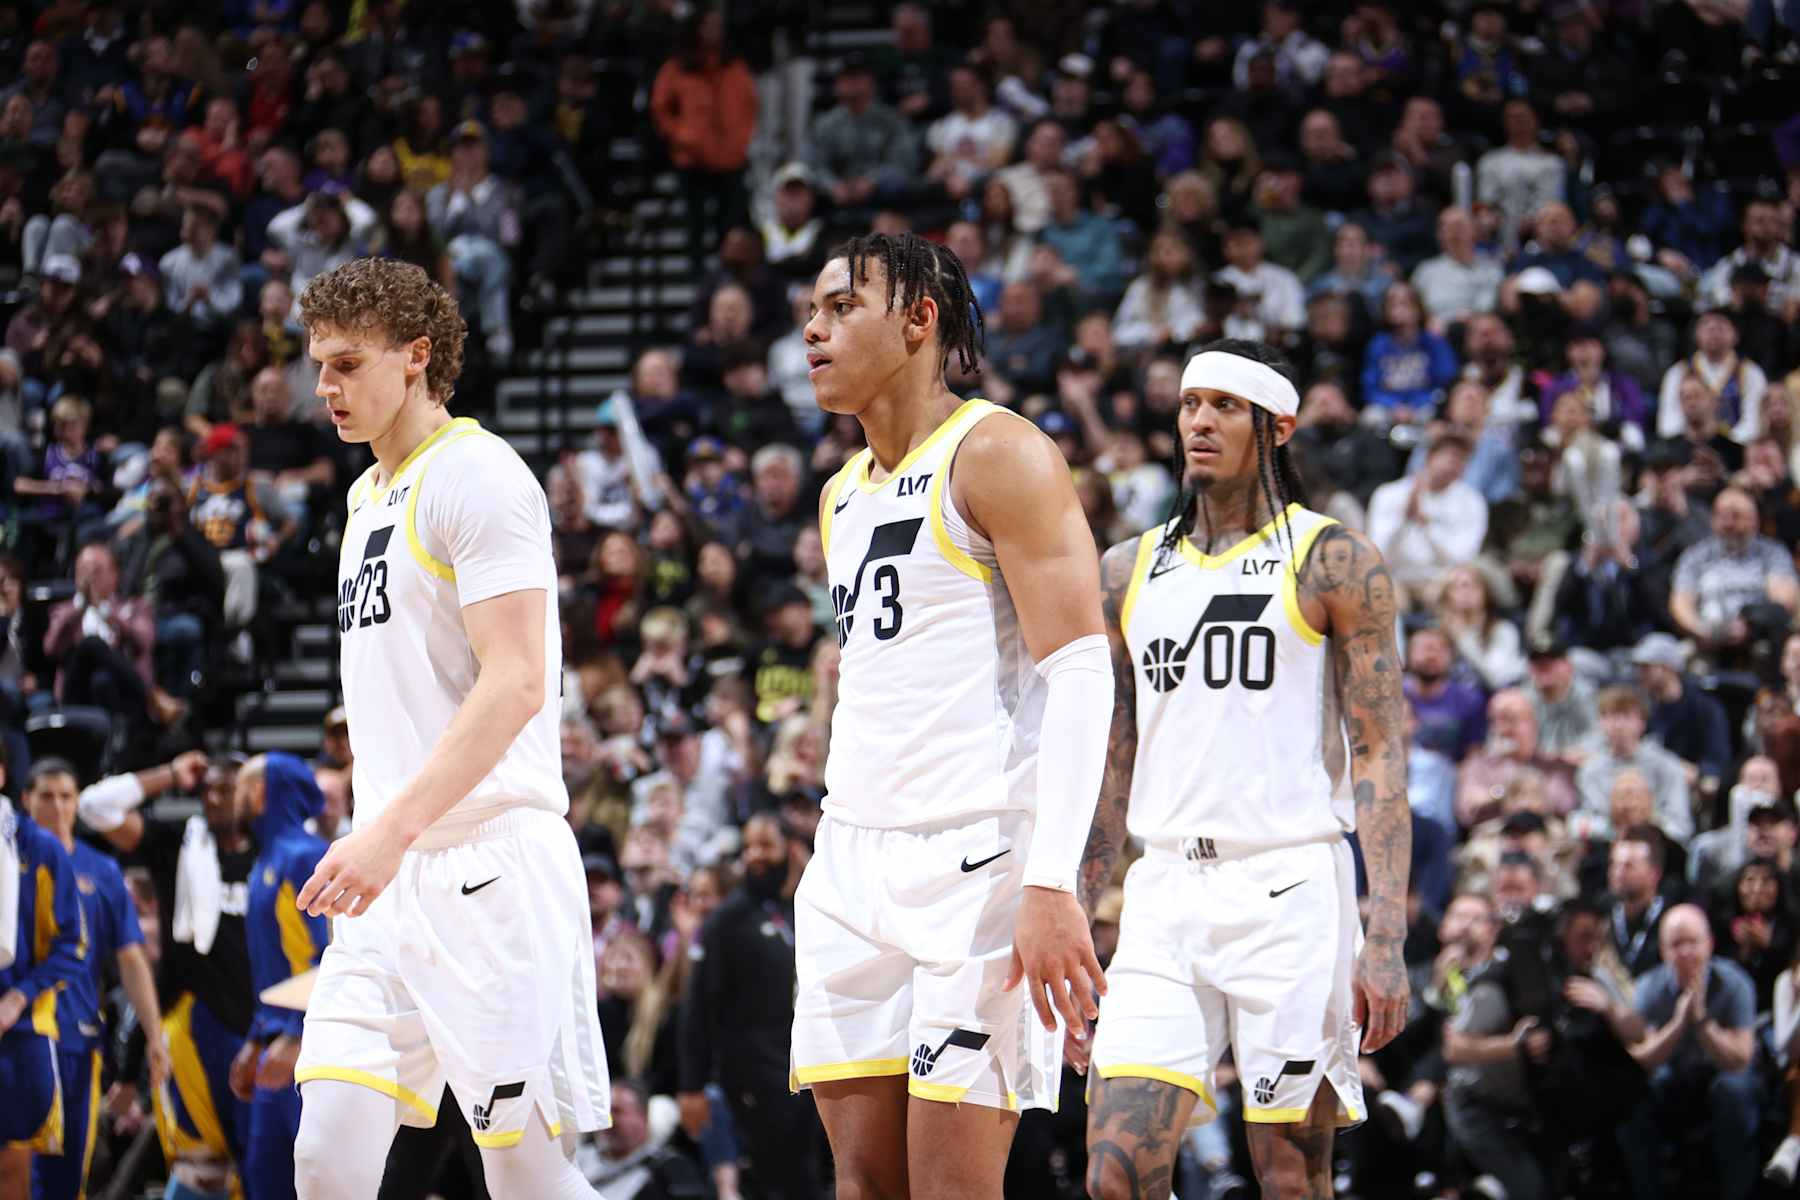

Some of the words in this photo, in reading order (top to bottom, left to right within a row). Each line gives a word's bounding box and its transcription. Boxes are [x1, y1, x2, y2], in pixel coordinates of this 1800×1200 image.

[387, 485, 410, 506] LVT
[898, 473, 933, 497] LVT
[1241, 559, 1281, 575] LVT
[359, 560, 391, 628] 23
[873, 564, 903, 641] 3
[1203, 625, 1276, 691] 00
[1186, 836, 1218, 861] AH
